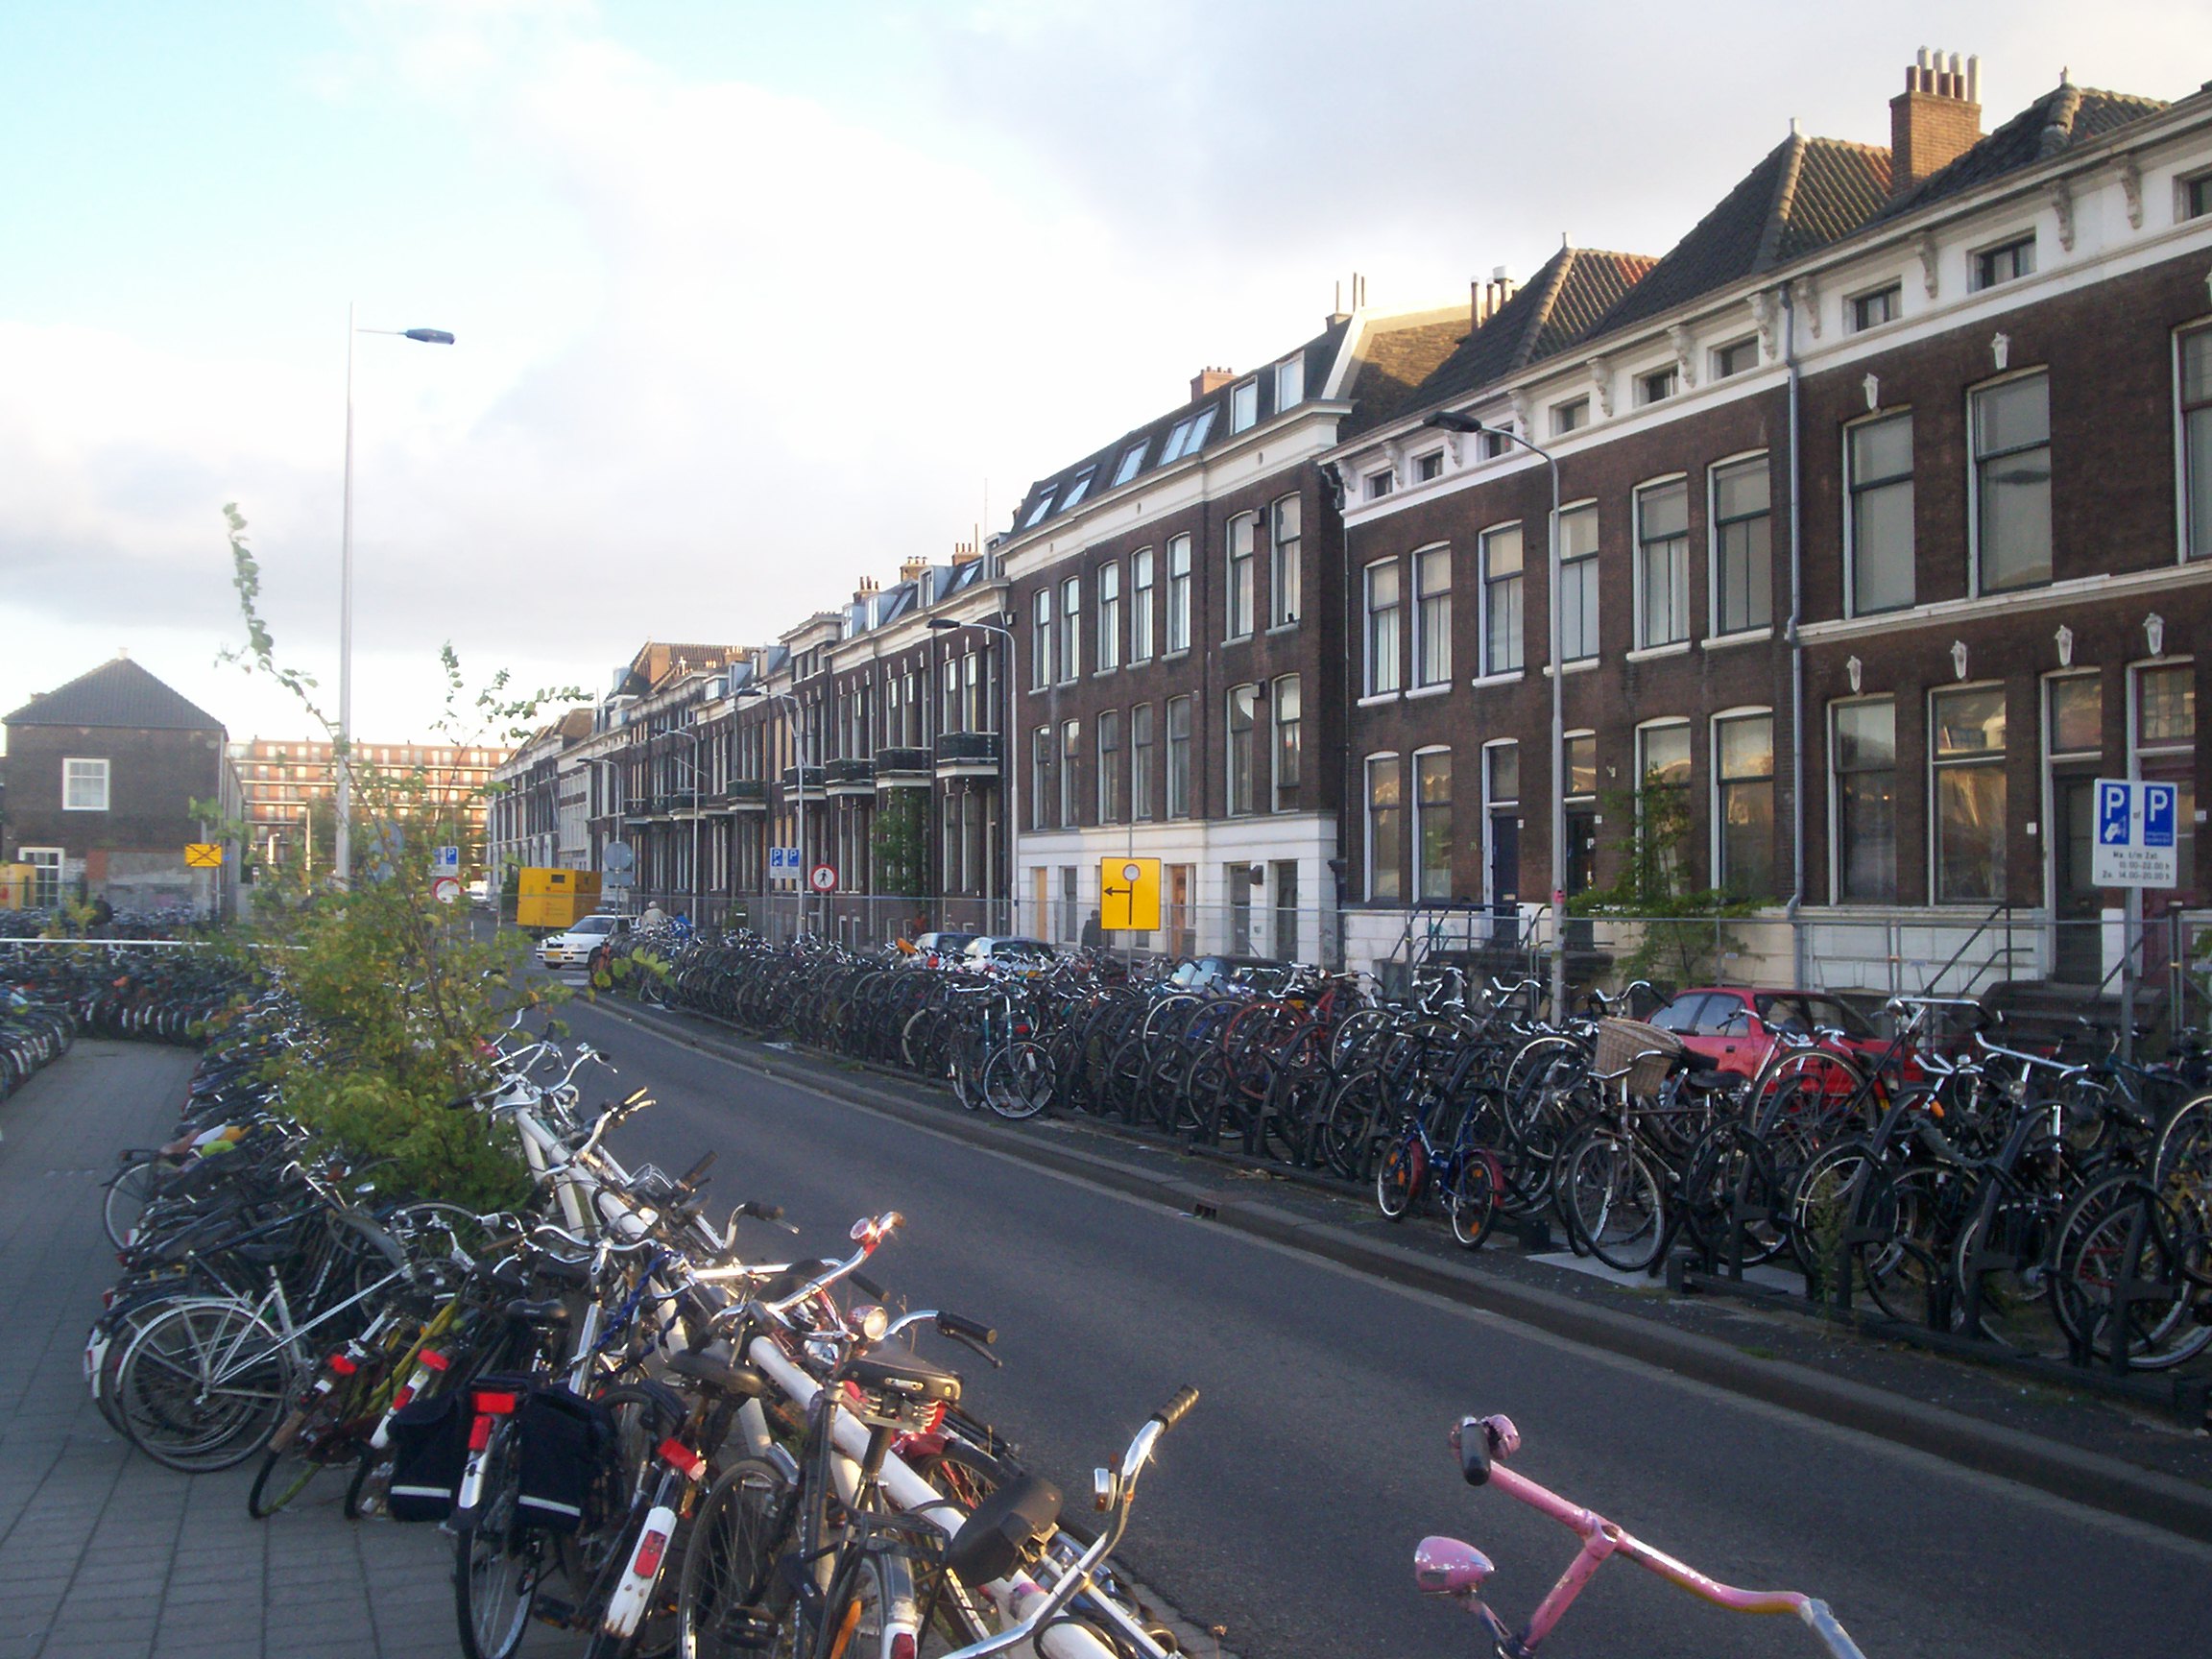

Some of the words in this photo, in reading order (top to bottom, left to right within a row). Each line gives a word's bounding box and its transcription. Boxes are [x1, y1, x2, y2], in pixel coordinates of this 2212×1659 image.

[2106, 786, 2125, 819] P
[2151, 789, 2168, 822] P
[774, 850, 781, 859] P
[790, 851, 797, 859] P
